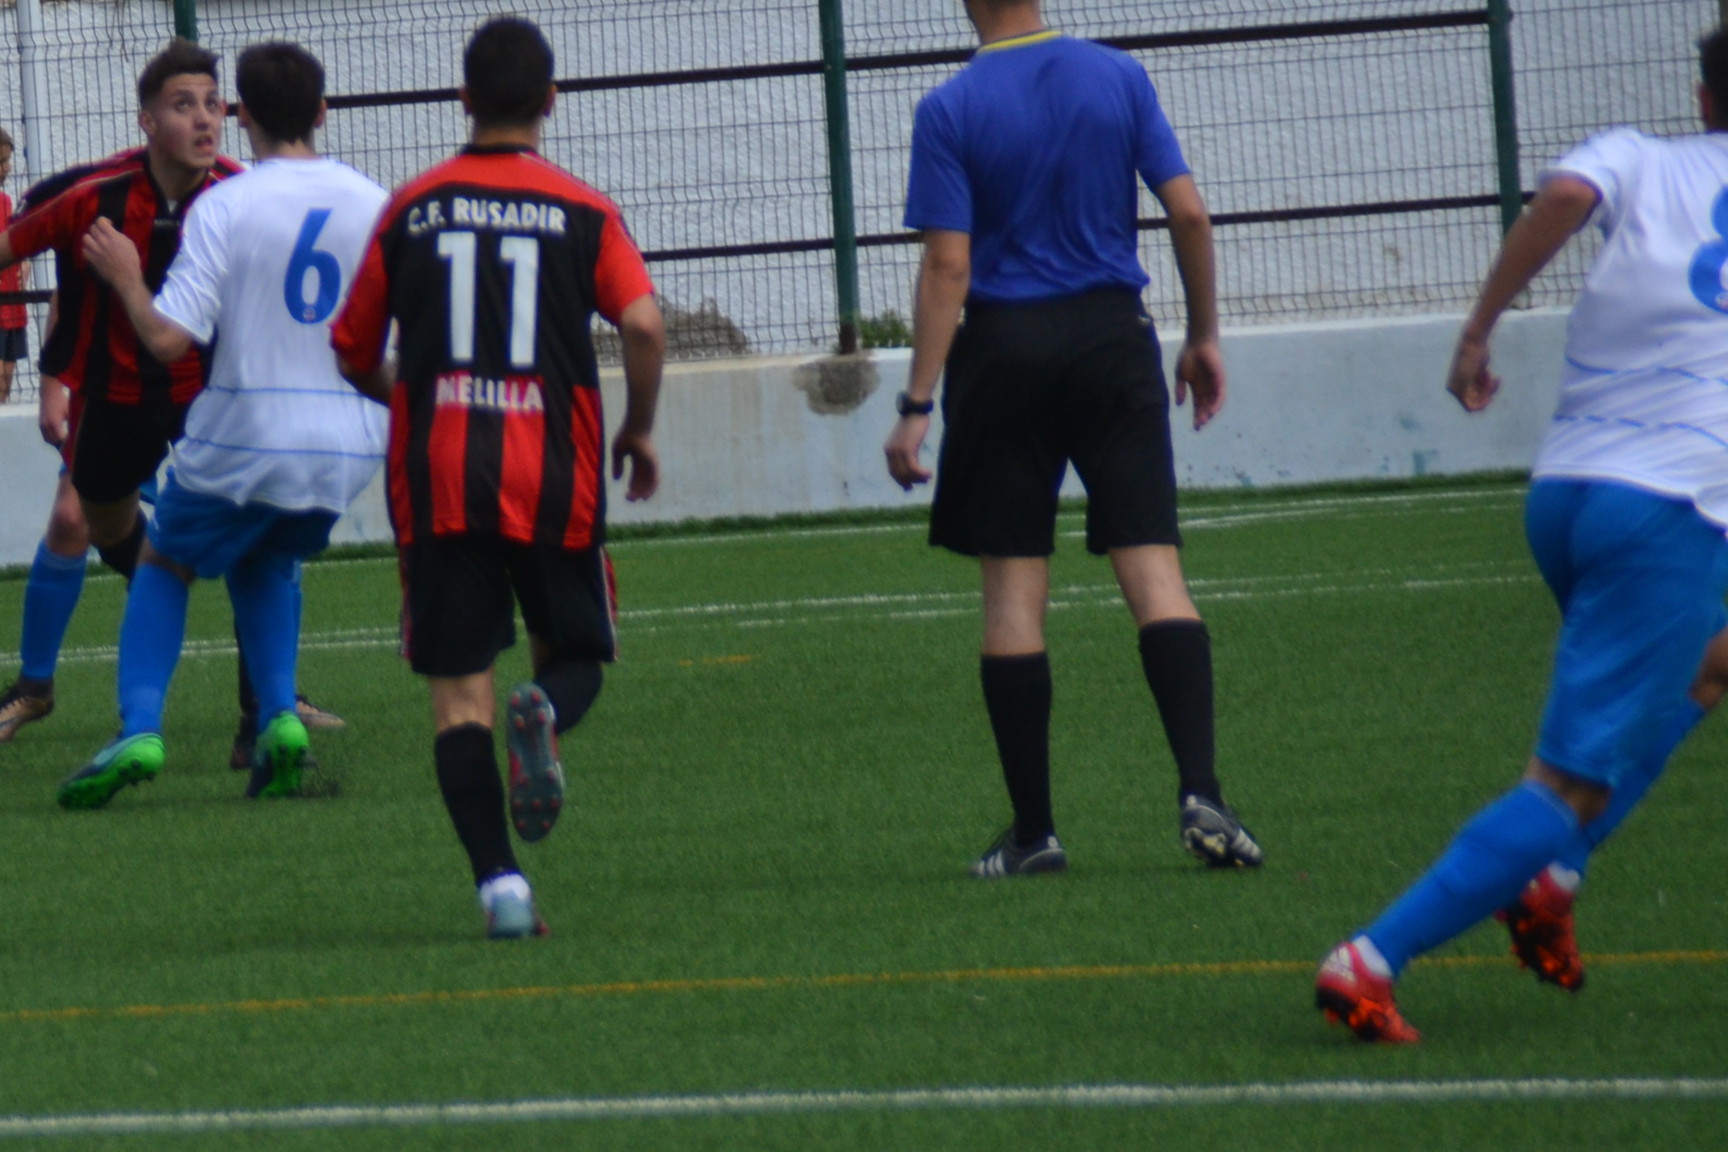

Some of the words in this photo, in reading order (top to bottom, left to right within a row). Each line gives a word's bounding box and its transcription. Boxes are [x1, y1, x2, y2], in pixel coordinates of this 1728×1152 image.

[407, 200, 446, 235] C.F.
[453, 197, 566, 234] RUSADIR
[284, 207, 341, 324] 6
[437, 230, 539, 368] 11
[435, 375, 544, 412] MELILLA
